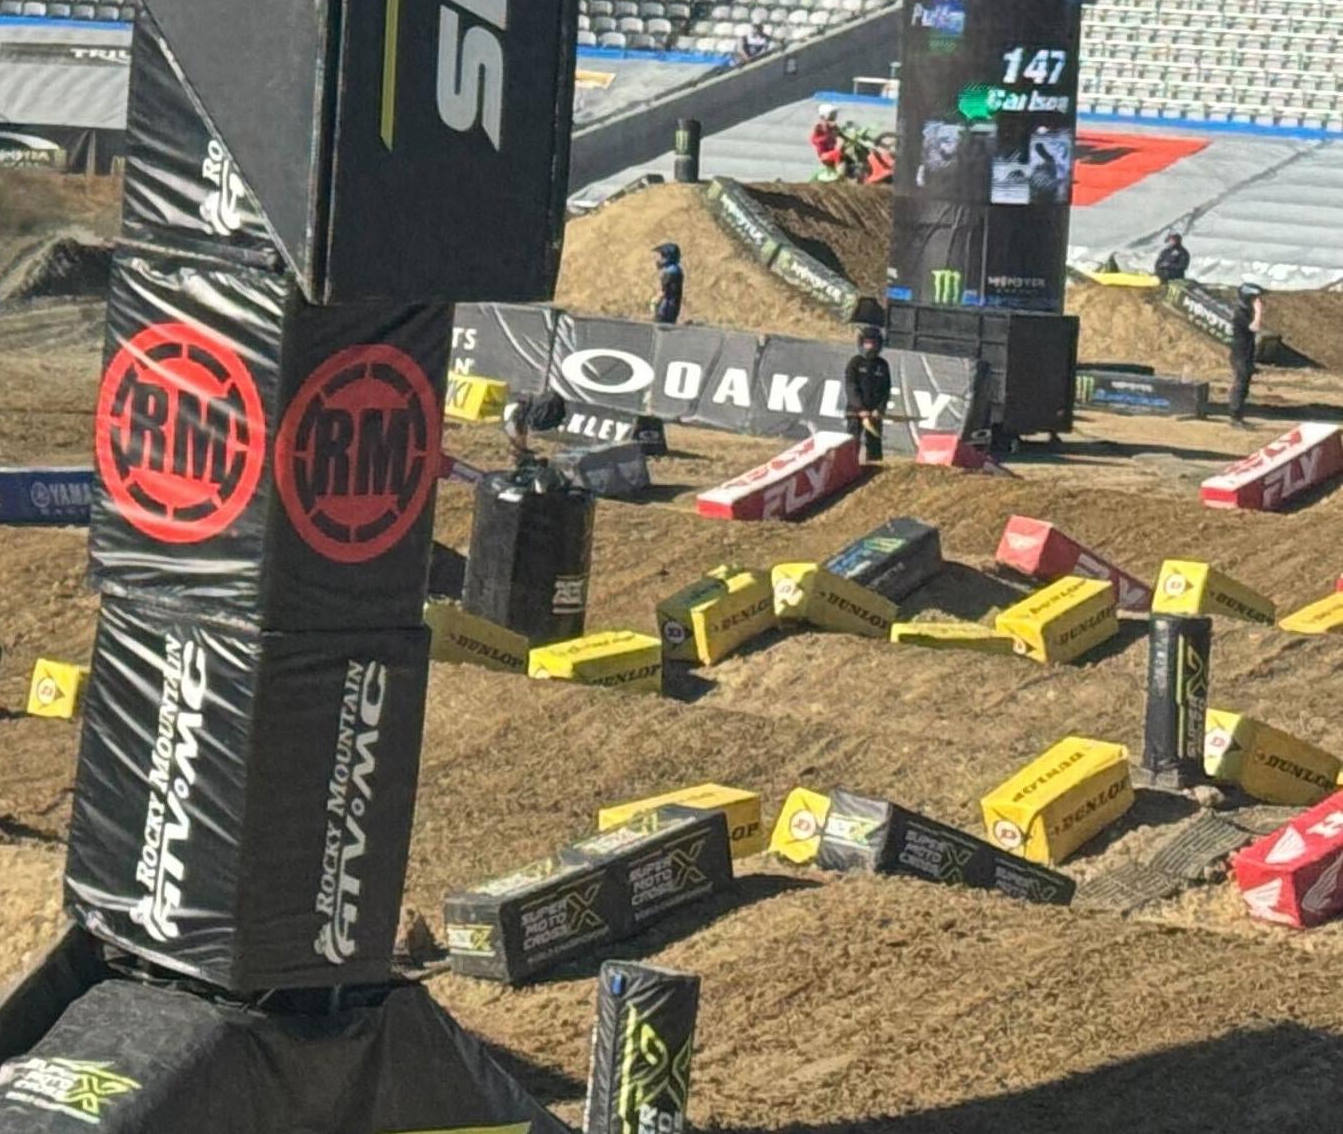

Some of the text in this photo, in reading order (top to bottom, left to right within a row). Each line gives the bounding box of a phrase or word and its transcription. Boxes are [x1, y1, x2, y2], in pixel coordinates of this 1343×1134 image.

[1002, 47, 1067, 84] 147
[663, 361, 952, 430] OAKLY
[48, 482, 92, 506] YAMA
[1060, 606, 1117, 648] DUNLOP
[1214, 592, 1273, 626] DUNLOP
[135, 633, 184, 892] ROCKY MOUNTAIN
[315, 658, 365, 916] ROCKY MOUNTAIN
[1061, 778, 1129, 834] DUNLOP
[524, 913, 569, 937] MOTO
